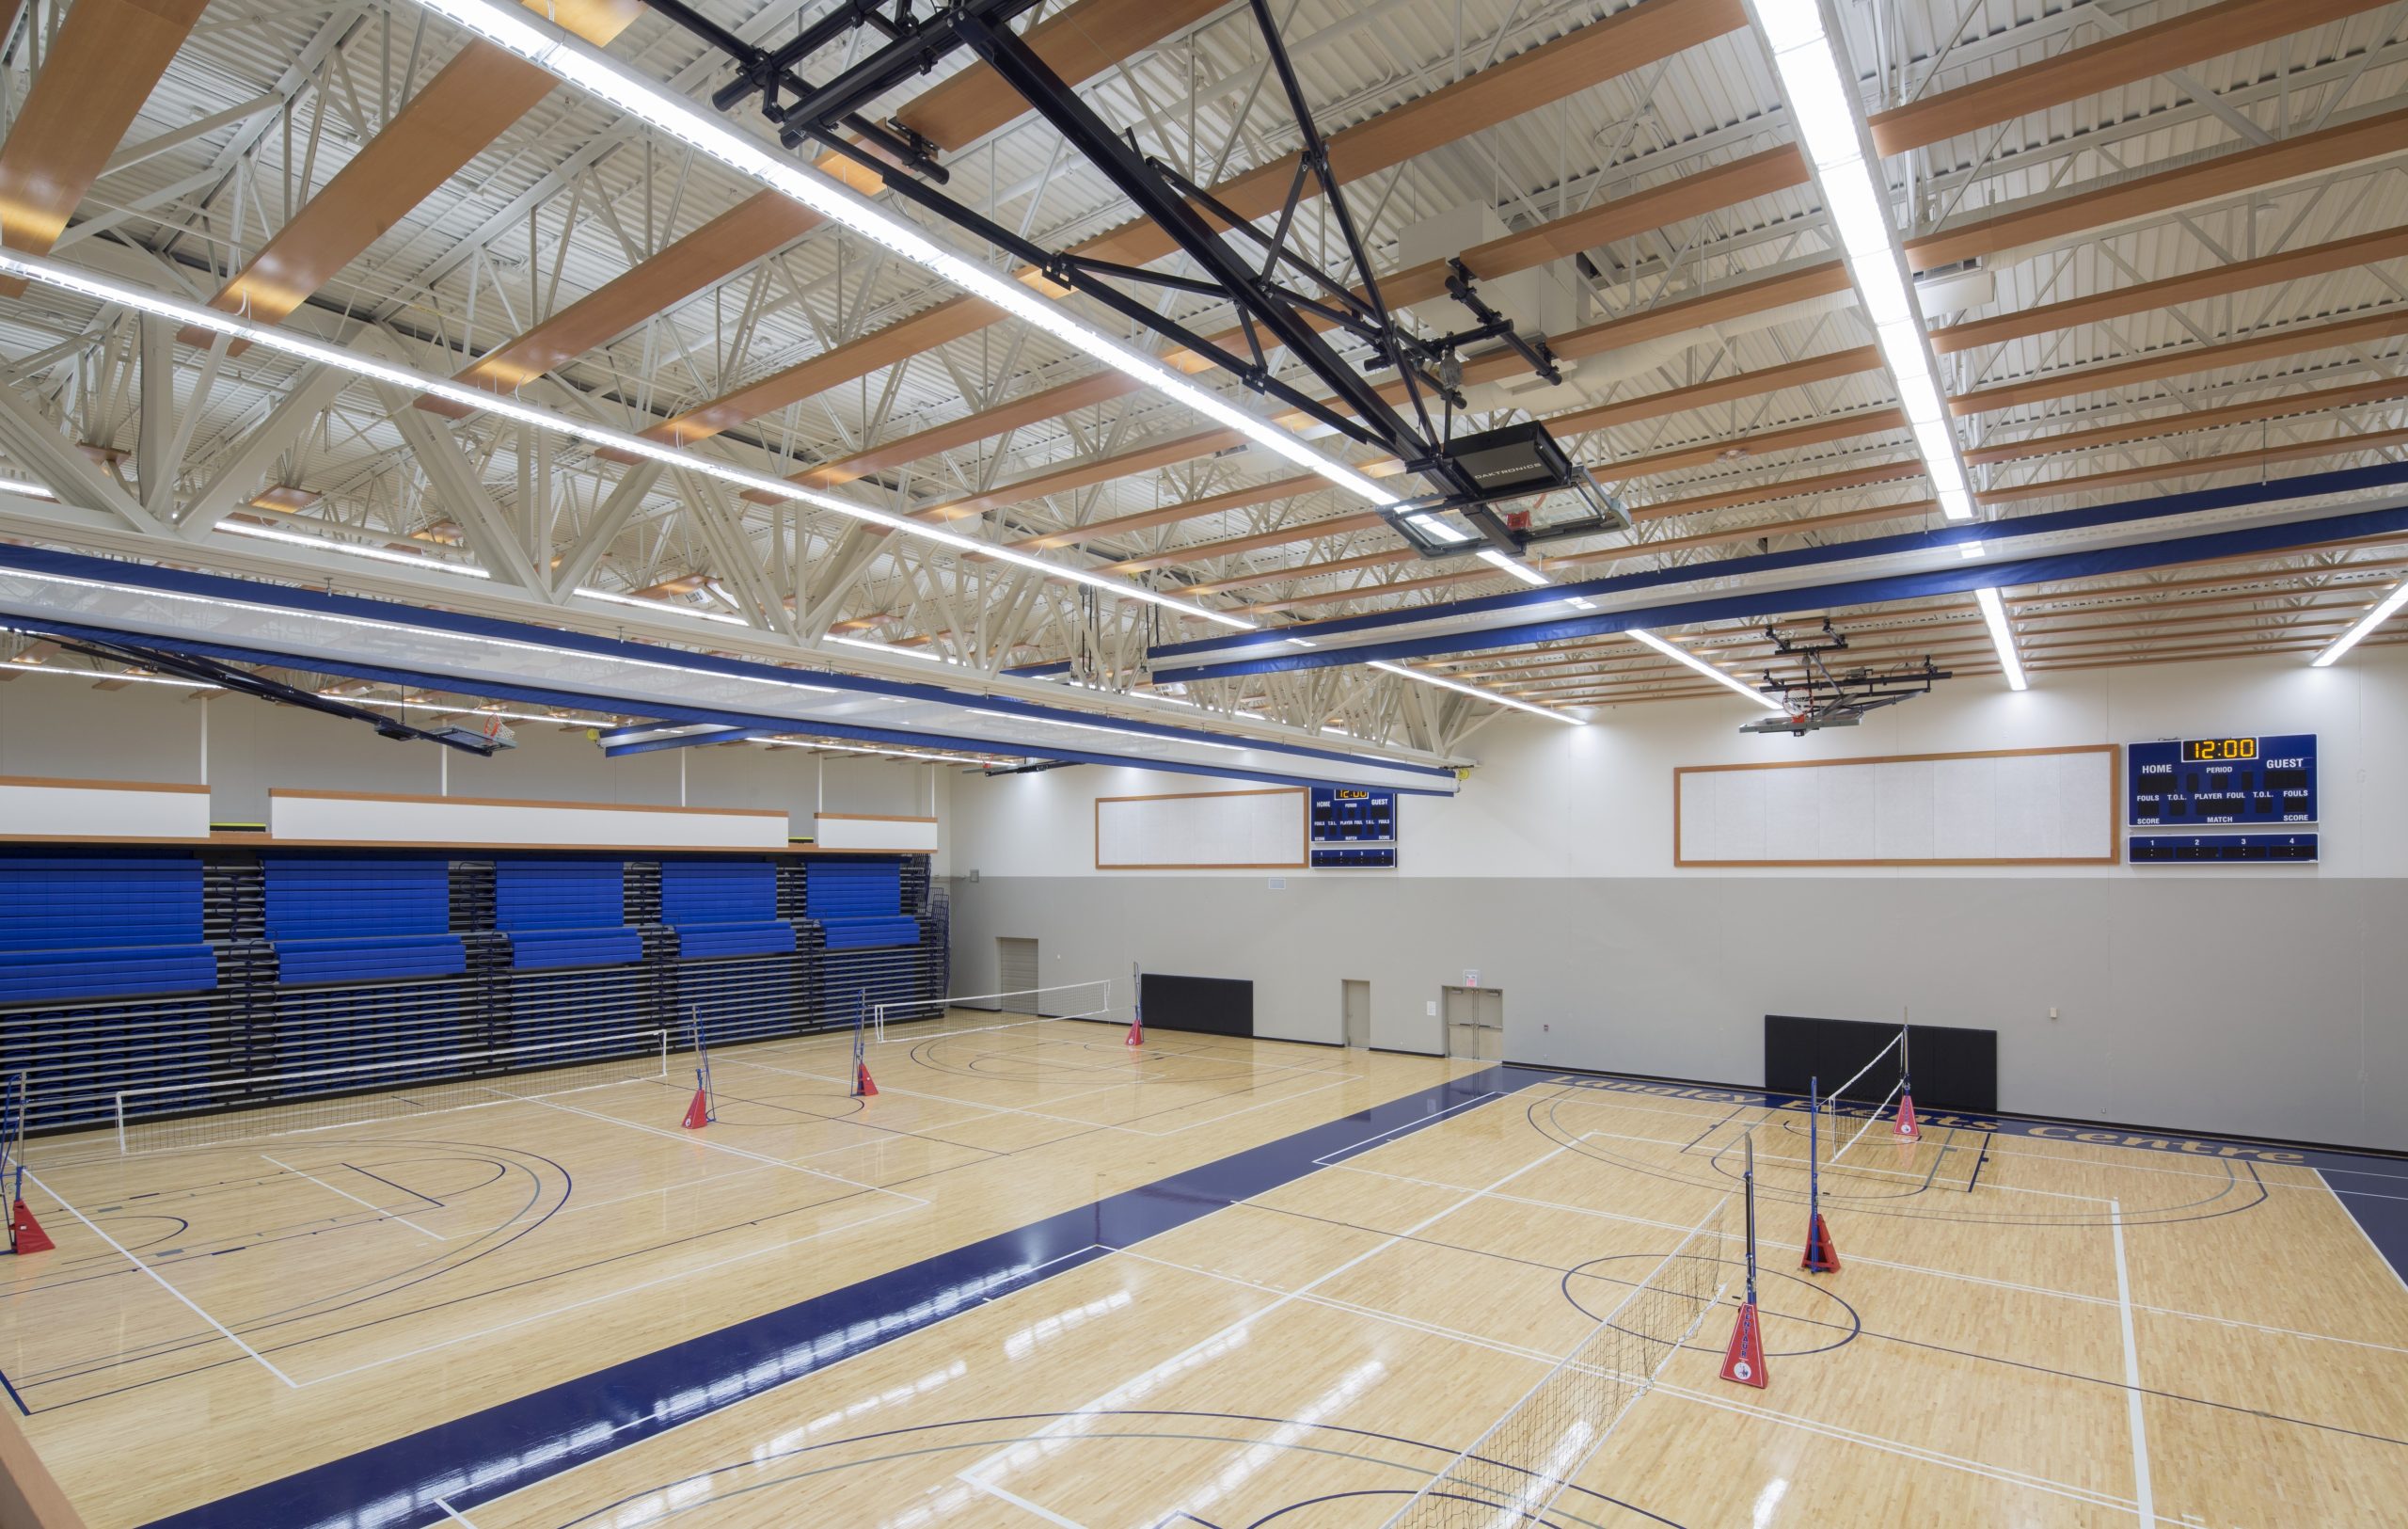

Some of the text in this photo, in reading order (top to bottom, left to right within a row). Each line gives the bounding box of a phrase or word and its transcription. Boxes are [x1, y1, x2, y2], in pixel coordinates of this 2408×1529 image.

[1474, 462, 1542, 479] DAKTRONICS
[2194, 739, 2254, 759] 12:00
[2142, 764, 2172, 774] HOME
[2267, 758, 2304, 769] GUEST
[1547, 1075, 1766, 1104] Langley
[2028, 1126, 2305, 1164] Centre
